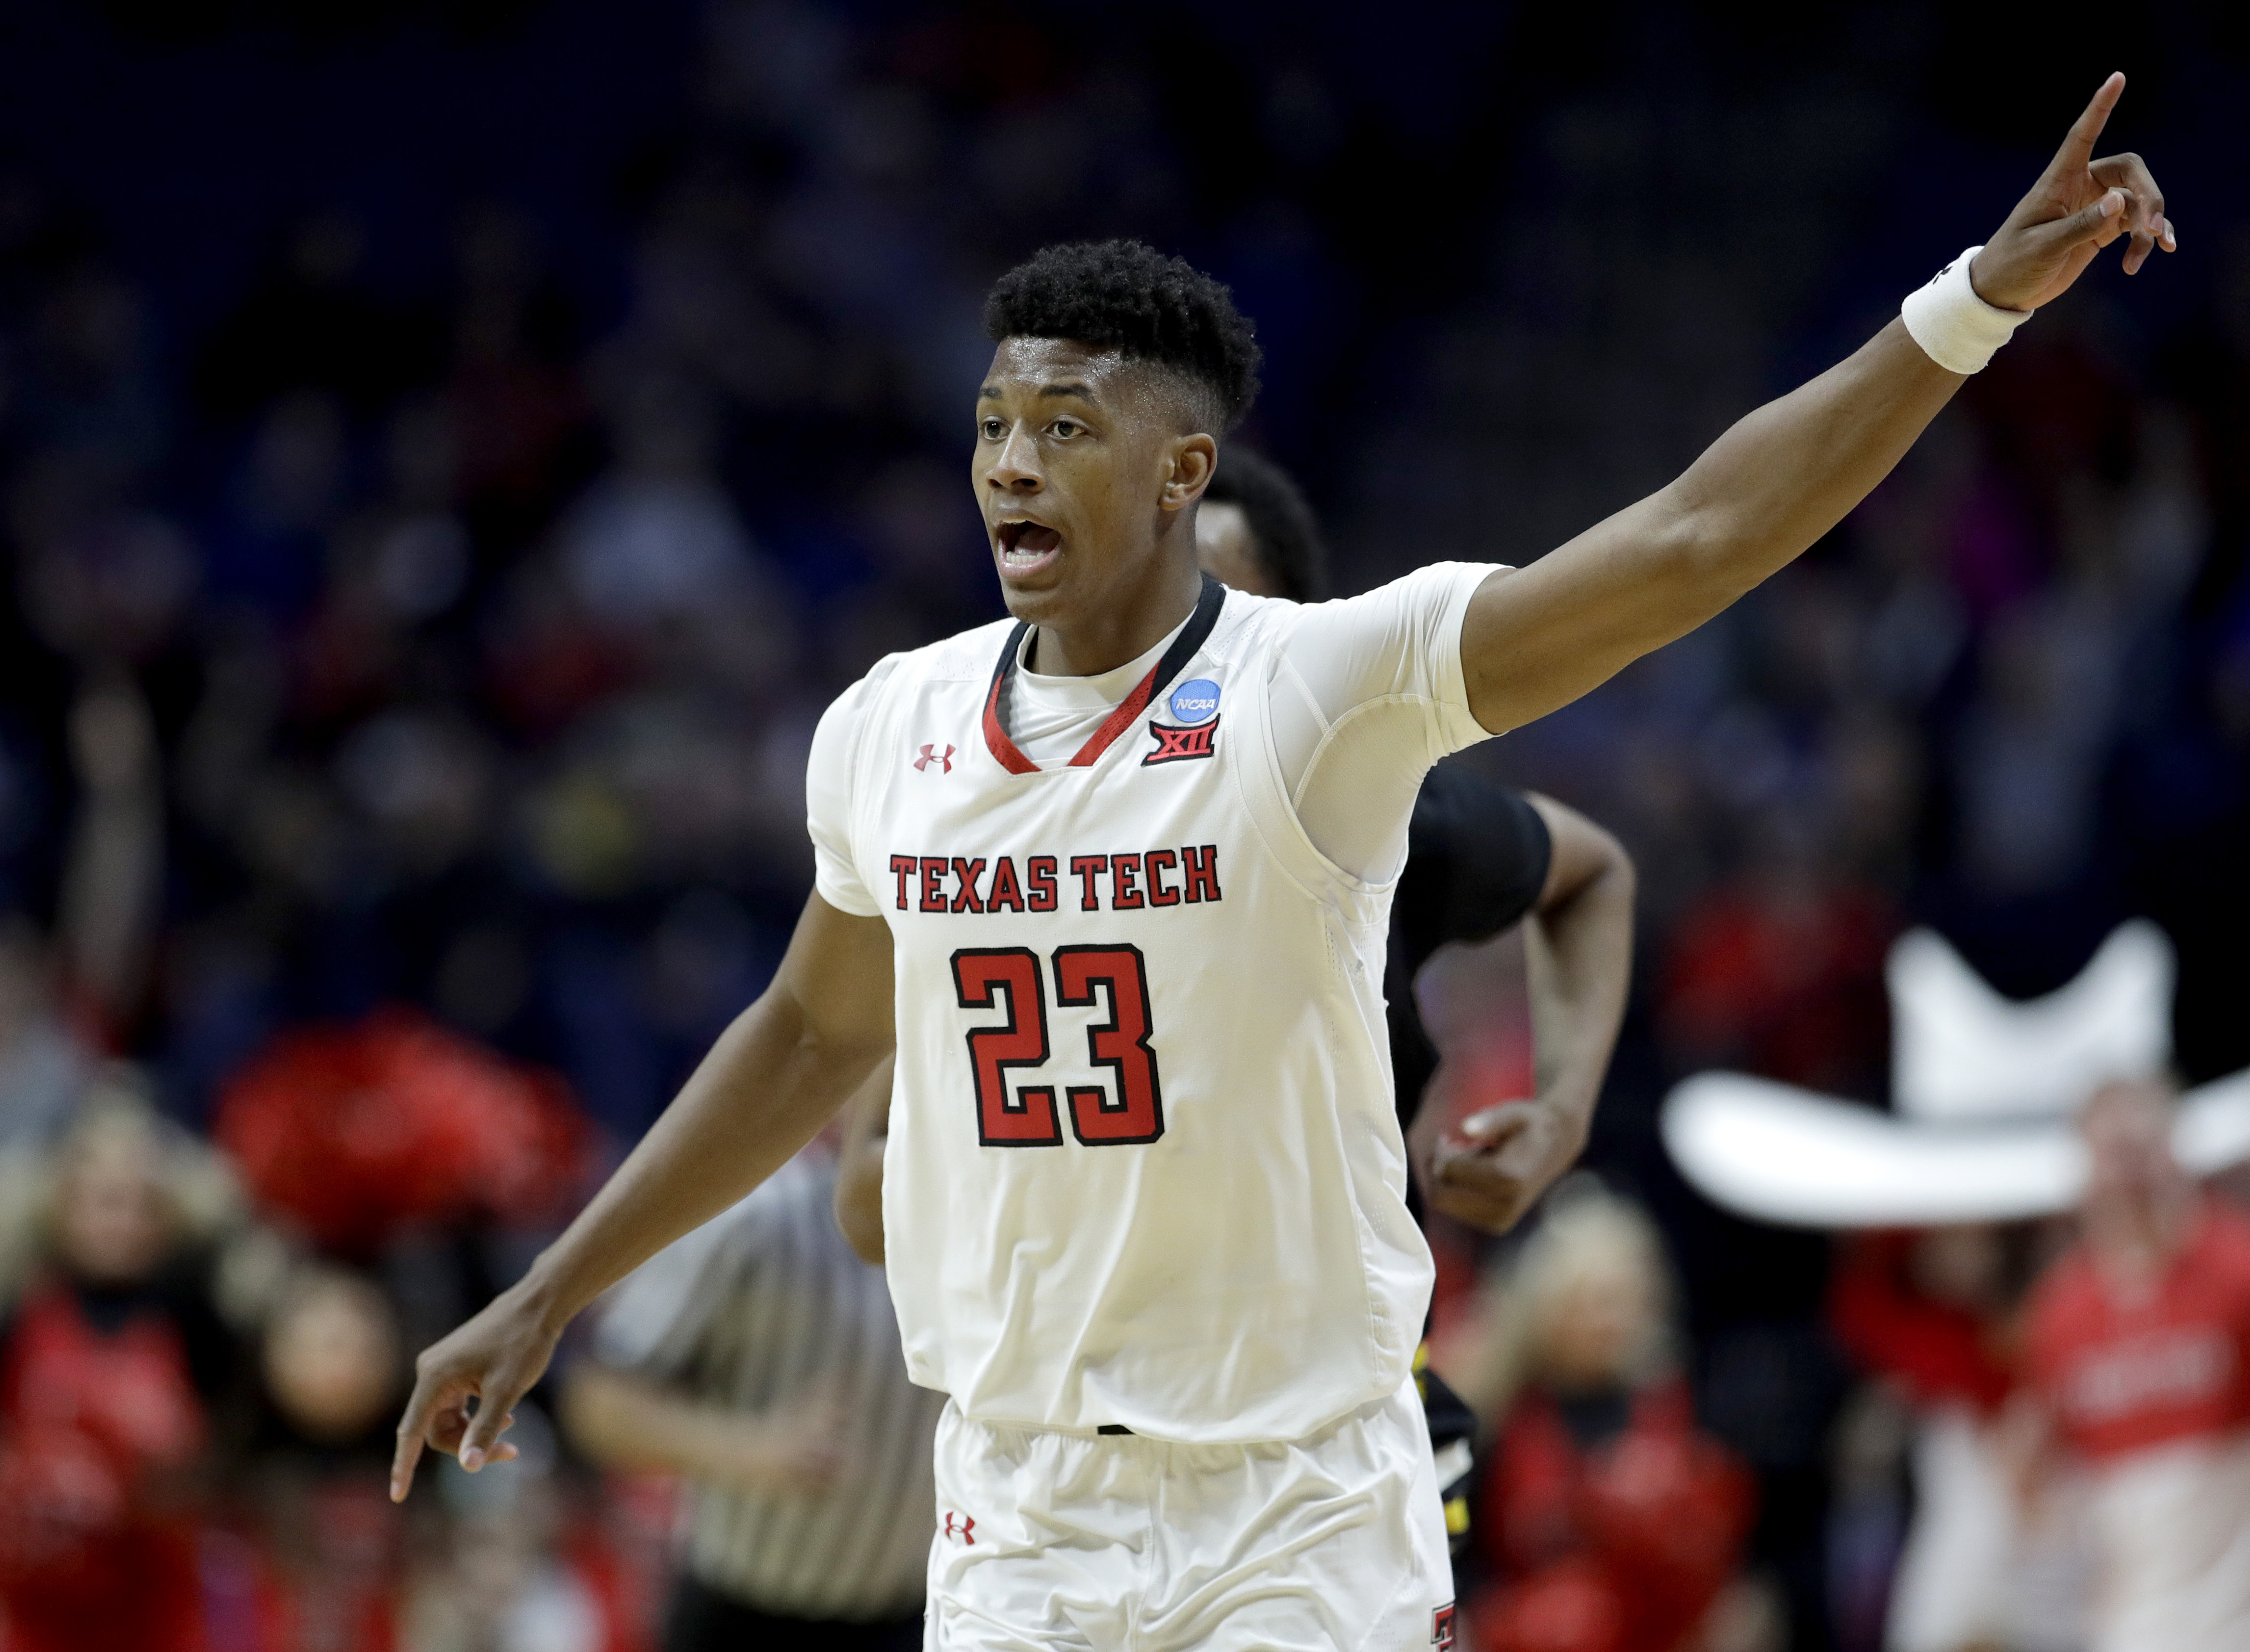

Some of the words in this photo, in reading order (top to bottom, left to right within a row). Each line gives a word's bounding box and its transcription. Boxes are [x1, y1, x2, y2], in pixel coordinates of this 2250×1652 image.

[1176, 698, 1216, 710] NCAA
[1143, 715, 1219, 765] XII
[890, 854, 1059, 914] TEXAS
[1070, 844, 1222, 911] TECH
[949, 942, 1165, 1148] 23
